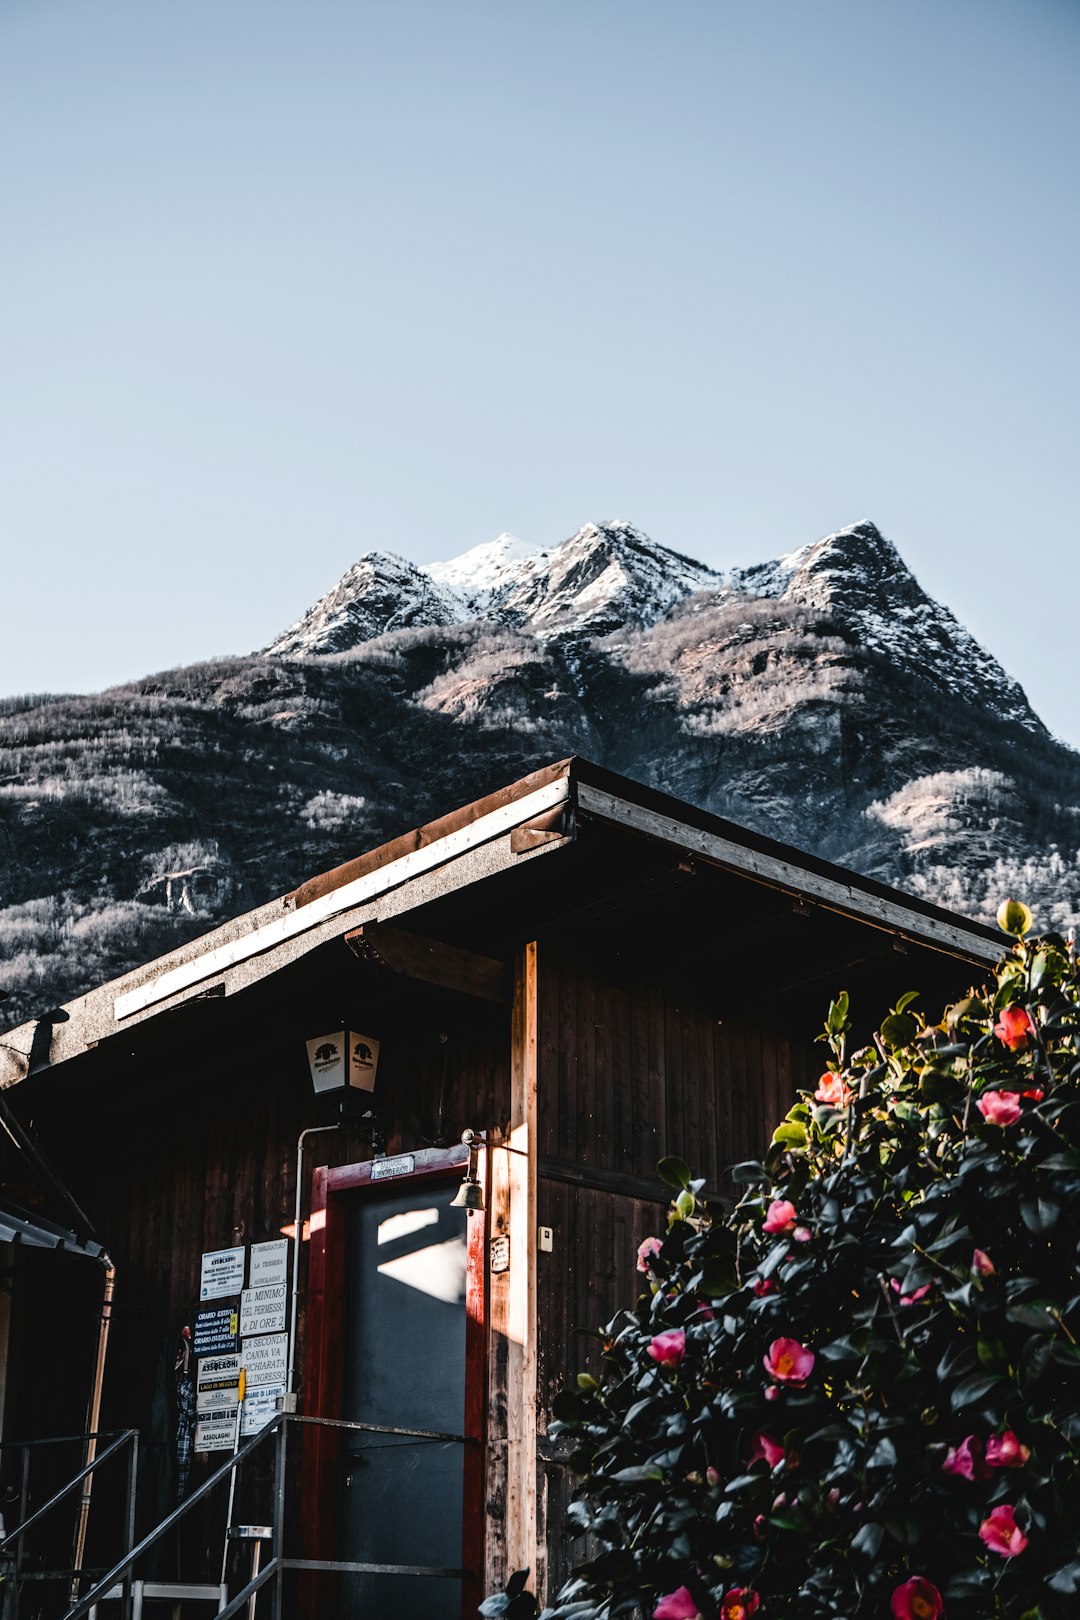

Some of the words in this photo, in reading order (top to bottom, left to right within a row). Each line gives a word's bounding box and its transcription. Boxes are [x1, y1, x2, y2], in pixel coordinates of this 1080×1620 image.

[376, 1168, 392, 1178] DENTRO
[257, 1242, 286, 1253] OBBLIGATORIA
[262, 1259, 283, 1268] TESSERA
[254, 1276, 281, 1285] ASSOLAGHI
[245, 1293, 252, 1303] IL
[255, 1288, 285, 1301] MINIMO
[198, 1312, 216, 1320] ORARIO
[217, 1309, 234, 1318] ESTIVO
[242, 1307, 252, 1317] DEL
[254, 1302, 285, 1315] PERMESSO
[249, 1320, 258, 1330] DI
[260, 1317, 277, 1329] ORE
[278, 1316, 284, 1326] 2
[194, 1336, 211, 1344] ORARIO
[243, 1340, 251, 1349] LA
[253, 1335, 286, 1347] SECONDA
[246, 1349, 269, 1360] CANNA
[271, 1347, 281, 1357] VA
[202, 1360, 238, 1372] ASSOLAGHI
[203, 1432, 230, 1440] ASSOLAGHI
